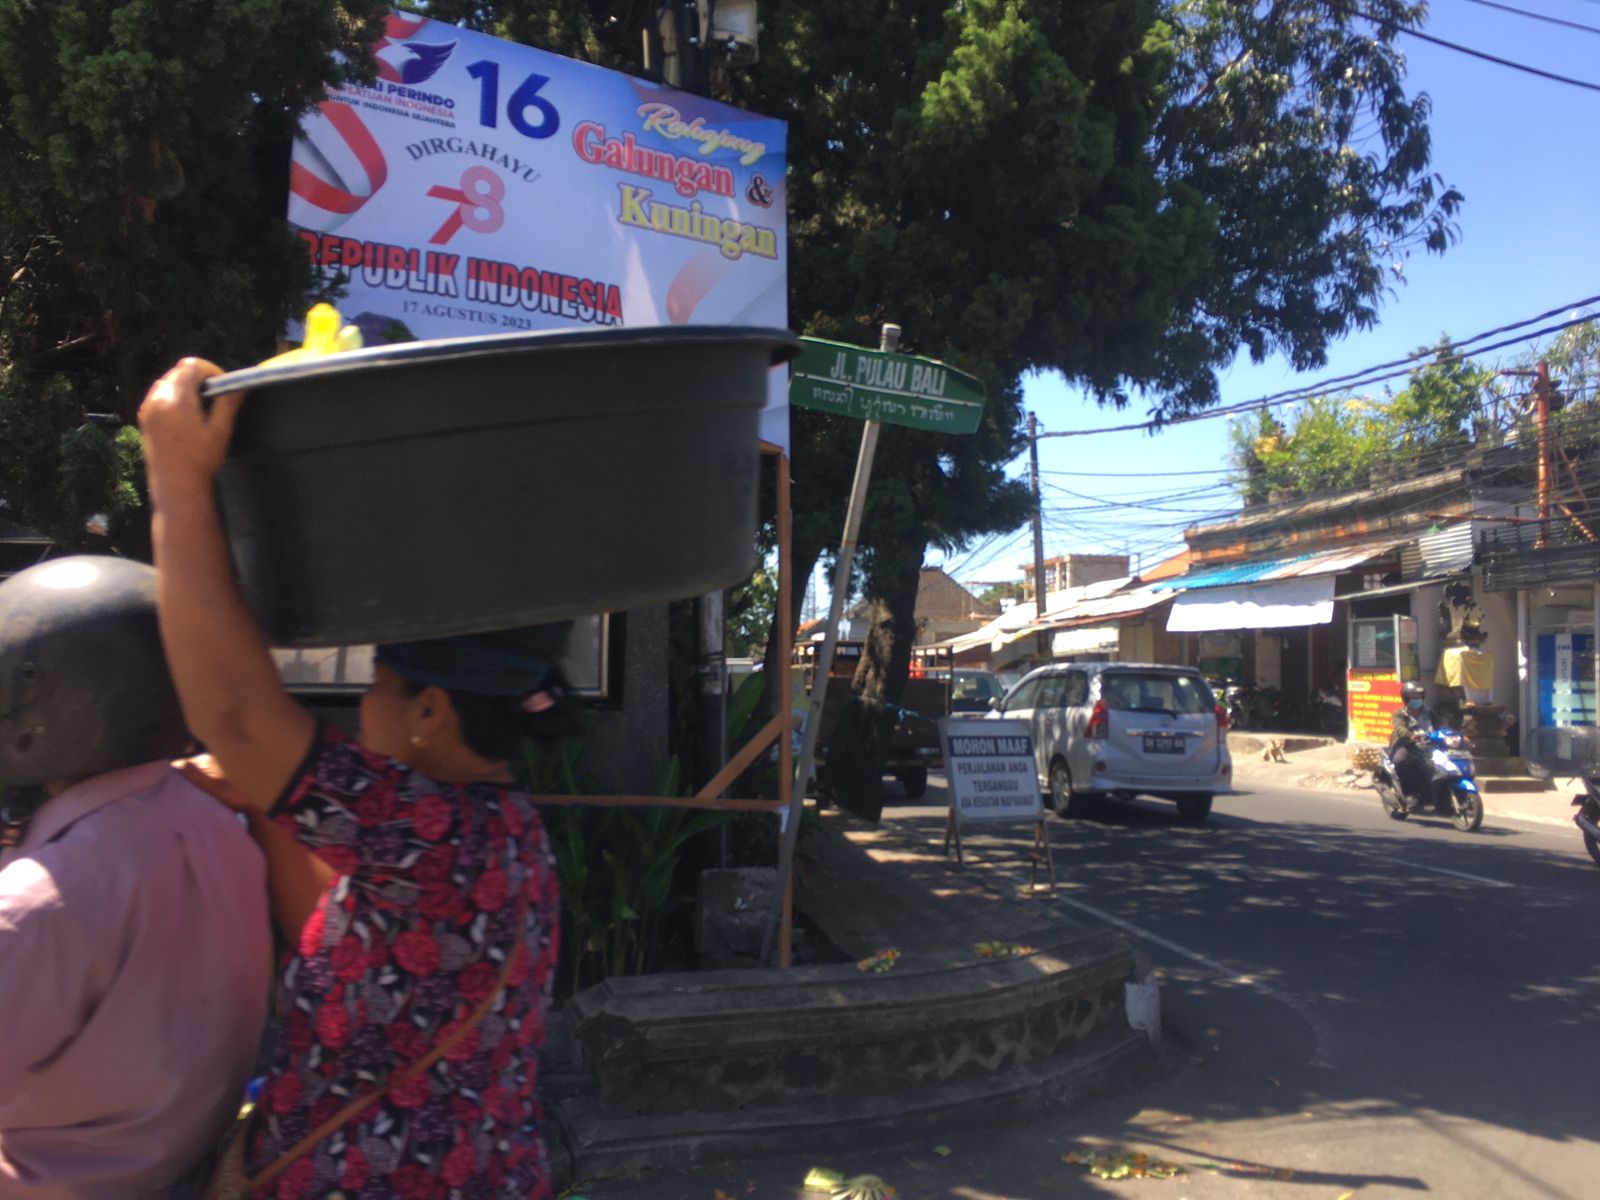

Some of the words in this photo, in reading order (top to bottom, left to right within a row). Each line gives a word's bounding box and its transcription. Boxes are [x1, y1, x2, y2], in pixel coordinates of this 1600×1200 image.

[387, 82, 455, 109] PERINDO
[394, 98, 455, 119] INDONESIA
[465, 59, 560, 140] 16
[404, 136, 541, 183] DIRGAHAYU
[572, 120, 735, 198] Galungan
[746, 173, 773, 208] &
[426, 165, 505, 245] 78
[617, 182, 778, 261] Kuningan
[466, 256, 624, 327] INDONESIA
[402, 300, 418, 313] 17
[421, 304, 498, 325] AGUSTUS
[502, 314, 531, 331] 2023
[830, 352, 852, 380] JL.
[856, 356, 907, 390] PULAU
[910, 365, 946, 396] BALI
[953, 739, 995, 755] MOHON
[997, 739, 1027, 754] MAAF
